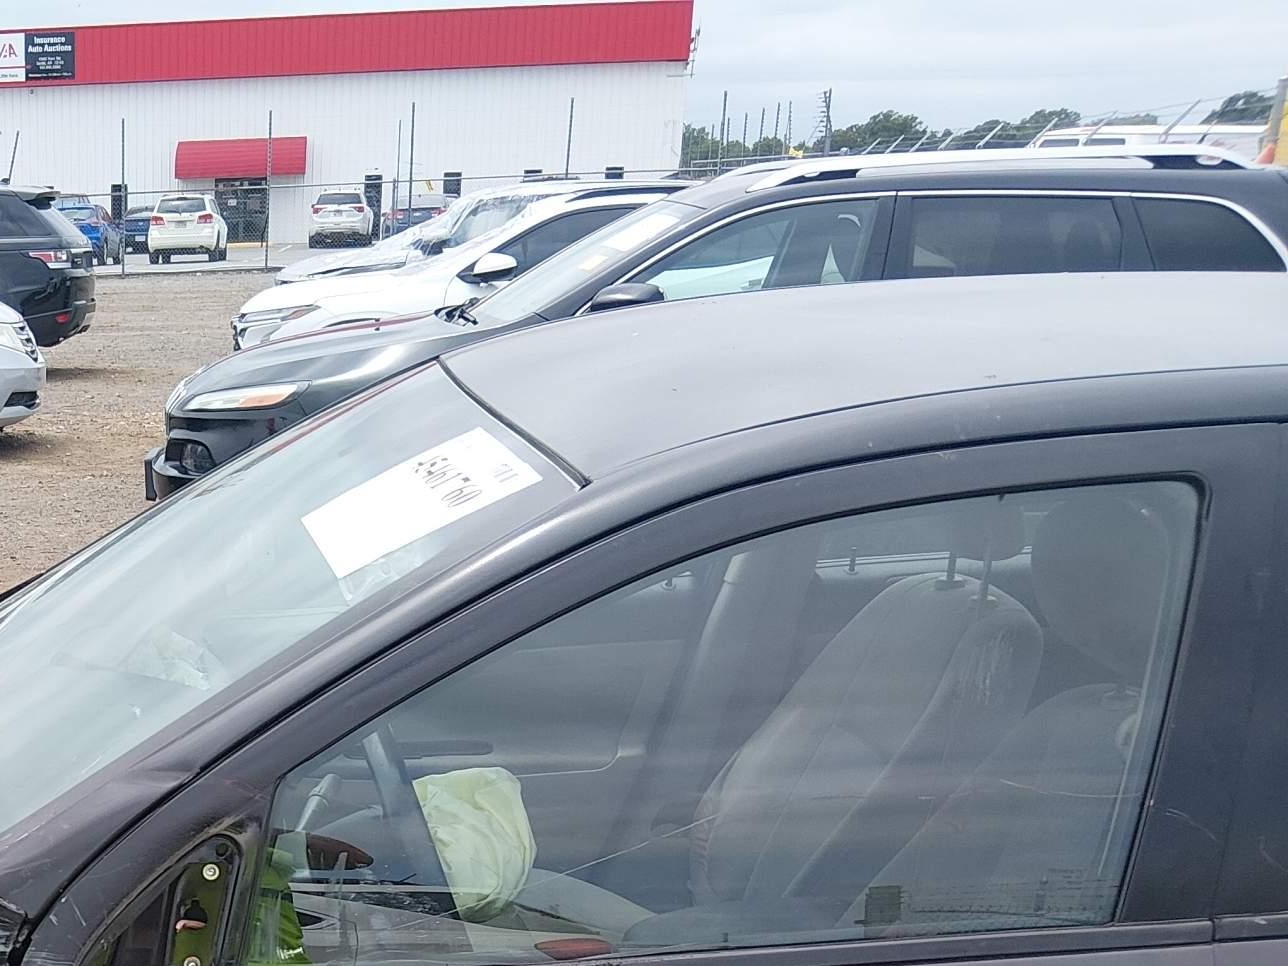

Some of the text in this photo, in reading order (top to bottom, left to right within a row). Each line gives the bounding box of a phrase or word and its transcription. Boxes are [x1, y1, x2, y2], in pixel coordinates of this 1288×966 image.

[34, 36, 65, 44] Insurance
[28, 44, 72, 53] Auto Auctions
